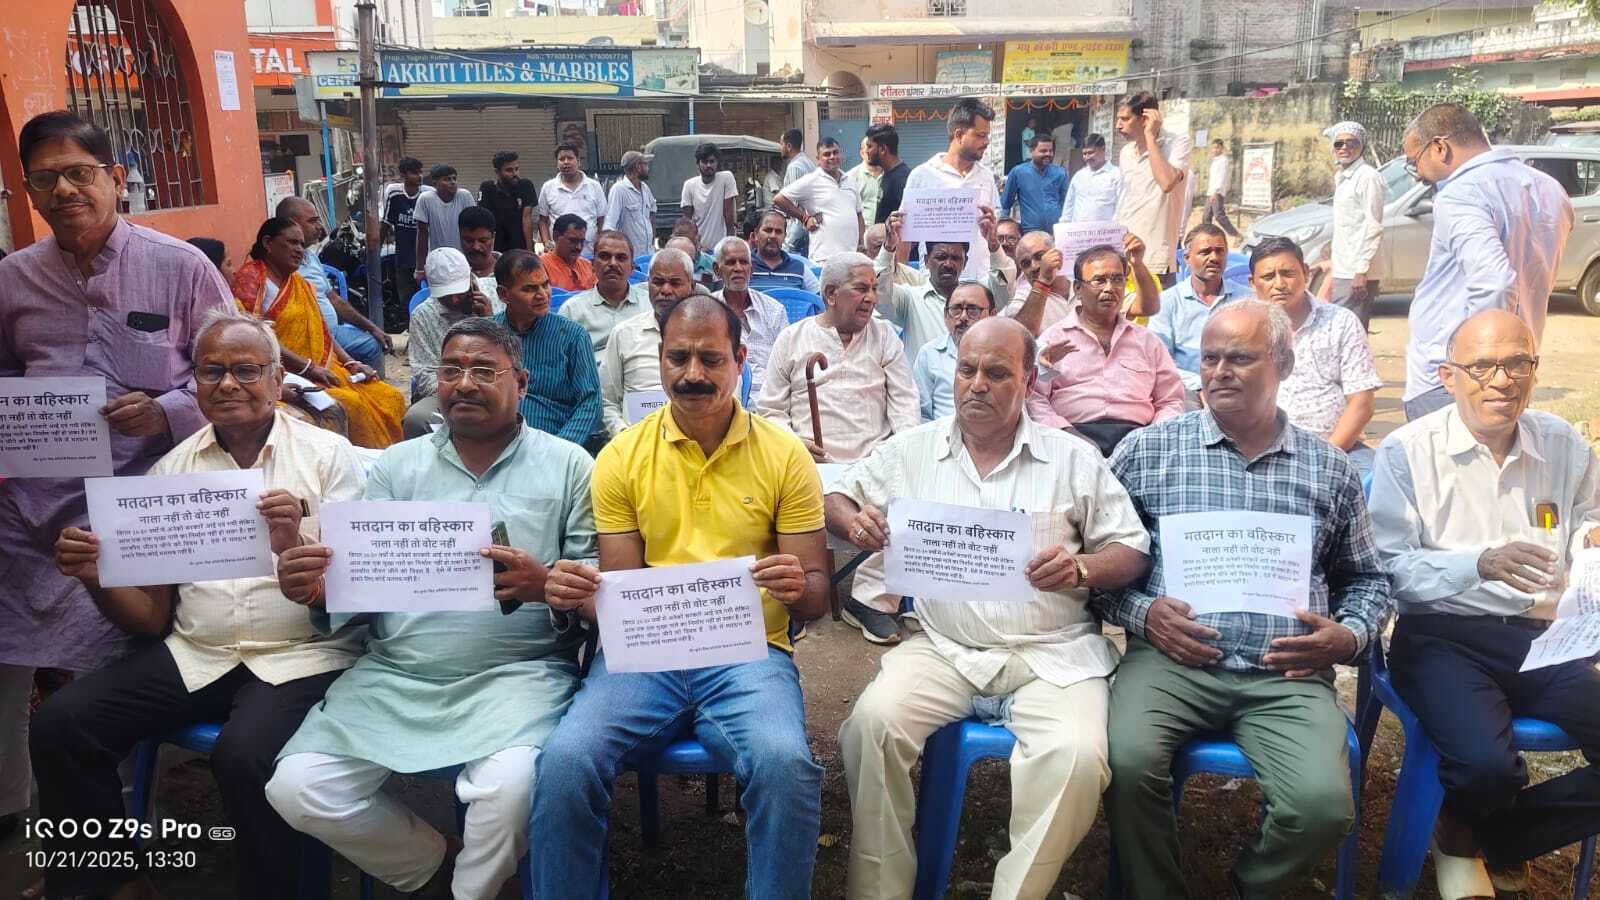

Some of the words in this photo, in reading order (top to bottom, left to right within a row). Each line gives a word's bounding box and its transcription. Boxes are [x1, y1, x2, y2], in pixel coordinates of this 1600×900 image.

[388, 63, 454, 82] AKRITI
[460, 62, 516, 82] TILES
[520, 62, 534, 82] &
[540, 62, 630, 82] MARBLES
[12, 396, 30, 406] का
[116, 494, 163, 510] मतदान
[166, 494, 185, 506] का
[139, 514, 160, 524] नाला
[163, 511, 180, 524] नहीं
[182, 510, 192, 521] तो
[194, 510, 210, 520] वोट
[213, 508, 229, 519] नहीं
[350, 520, 394, 532] मतदान
[397, 520, 415, 532] का
[908, 519, 944, 534] मतदान
[945, 524, 962, 536] का
[370, 539, 391, 548] नाला
[393, 538, 409, 549] नहीं
[410, 538, 420, 548] तो
[422, 538, 437, 548] वोट
[440, 538, 456, 548] नहीं
[922, 538, 940, 547] नाला
[942, 540, 956, 550] नहीं
[958, 542, 966, 550] तो
[968, 543, 981, 552] वोट
[983, 544, 998, 554] नहीं
[620, 586, 664, 601] मतदान
[666, 584, 684, 596] का
[642, 604, 662, 614] नाला
[664, 600, 680, 612] नहीं
[682, 600, 691, 610] तो
[694, 598, 708, 608] वोट
[710, 595, 726, 607] नहीं
